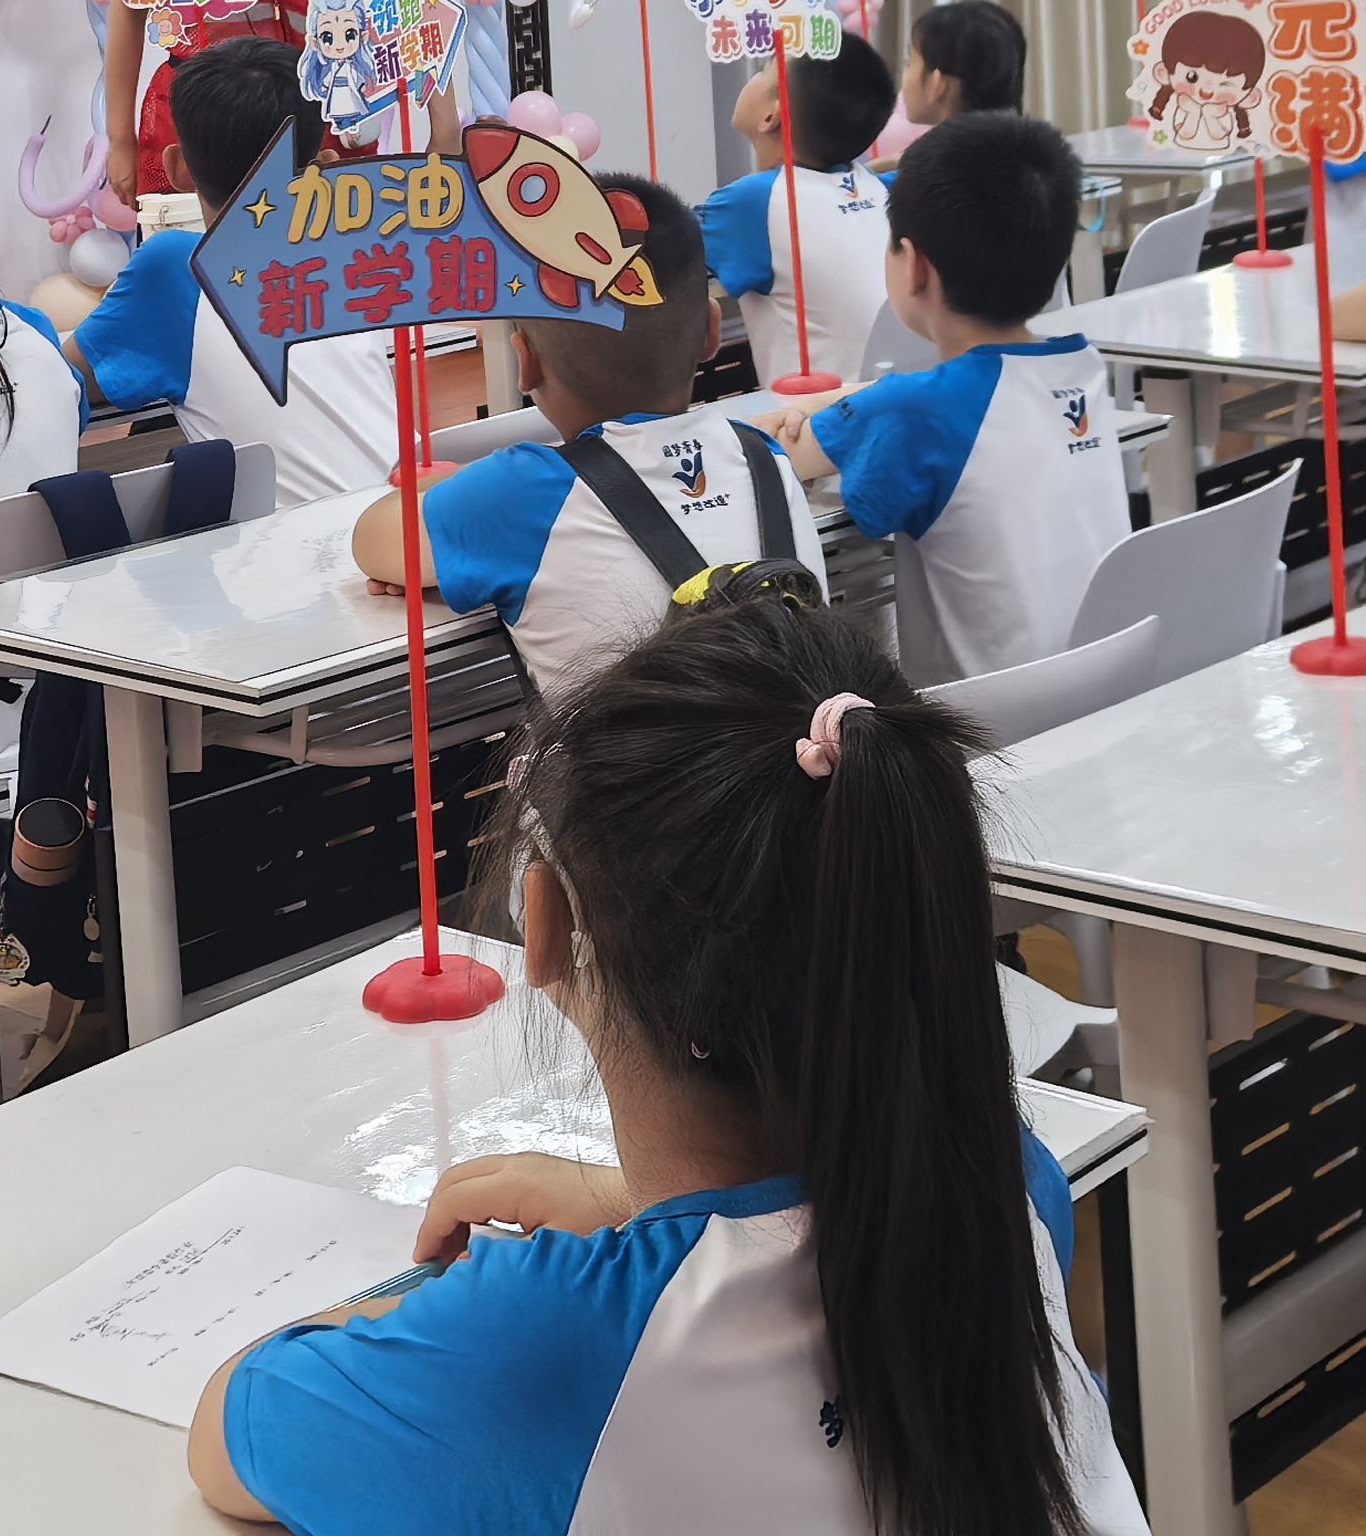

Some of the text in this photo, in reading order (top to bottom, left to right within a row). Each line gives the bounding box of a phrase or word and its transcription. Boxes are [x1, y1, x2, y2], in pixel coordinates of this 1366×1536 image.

[711, 8, 838, 54] 未来可期
[1145, 0, 1183, 34] GOOD
[374, 21, 445, 84] 新学期
[286, 153, 464, 244] 加油
[256, 235, 498, 339] 新学期
